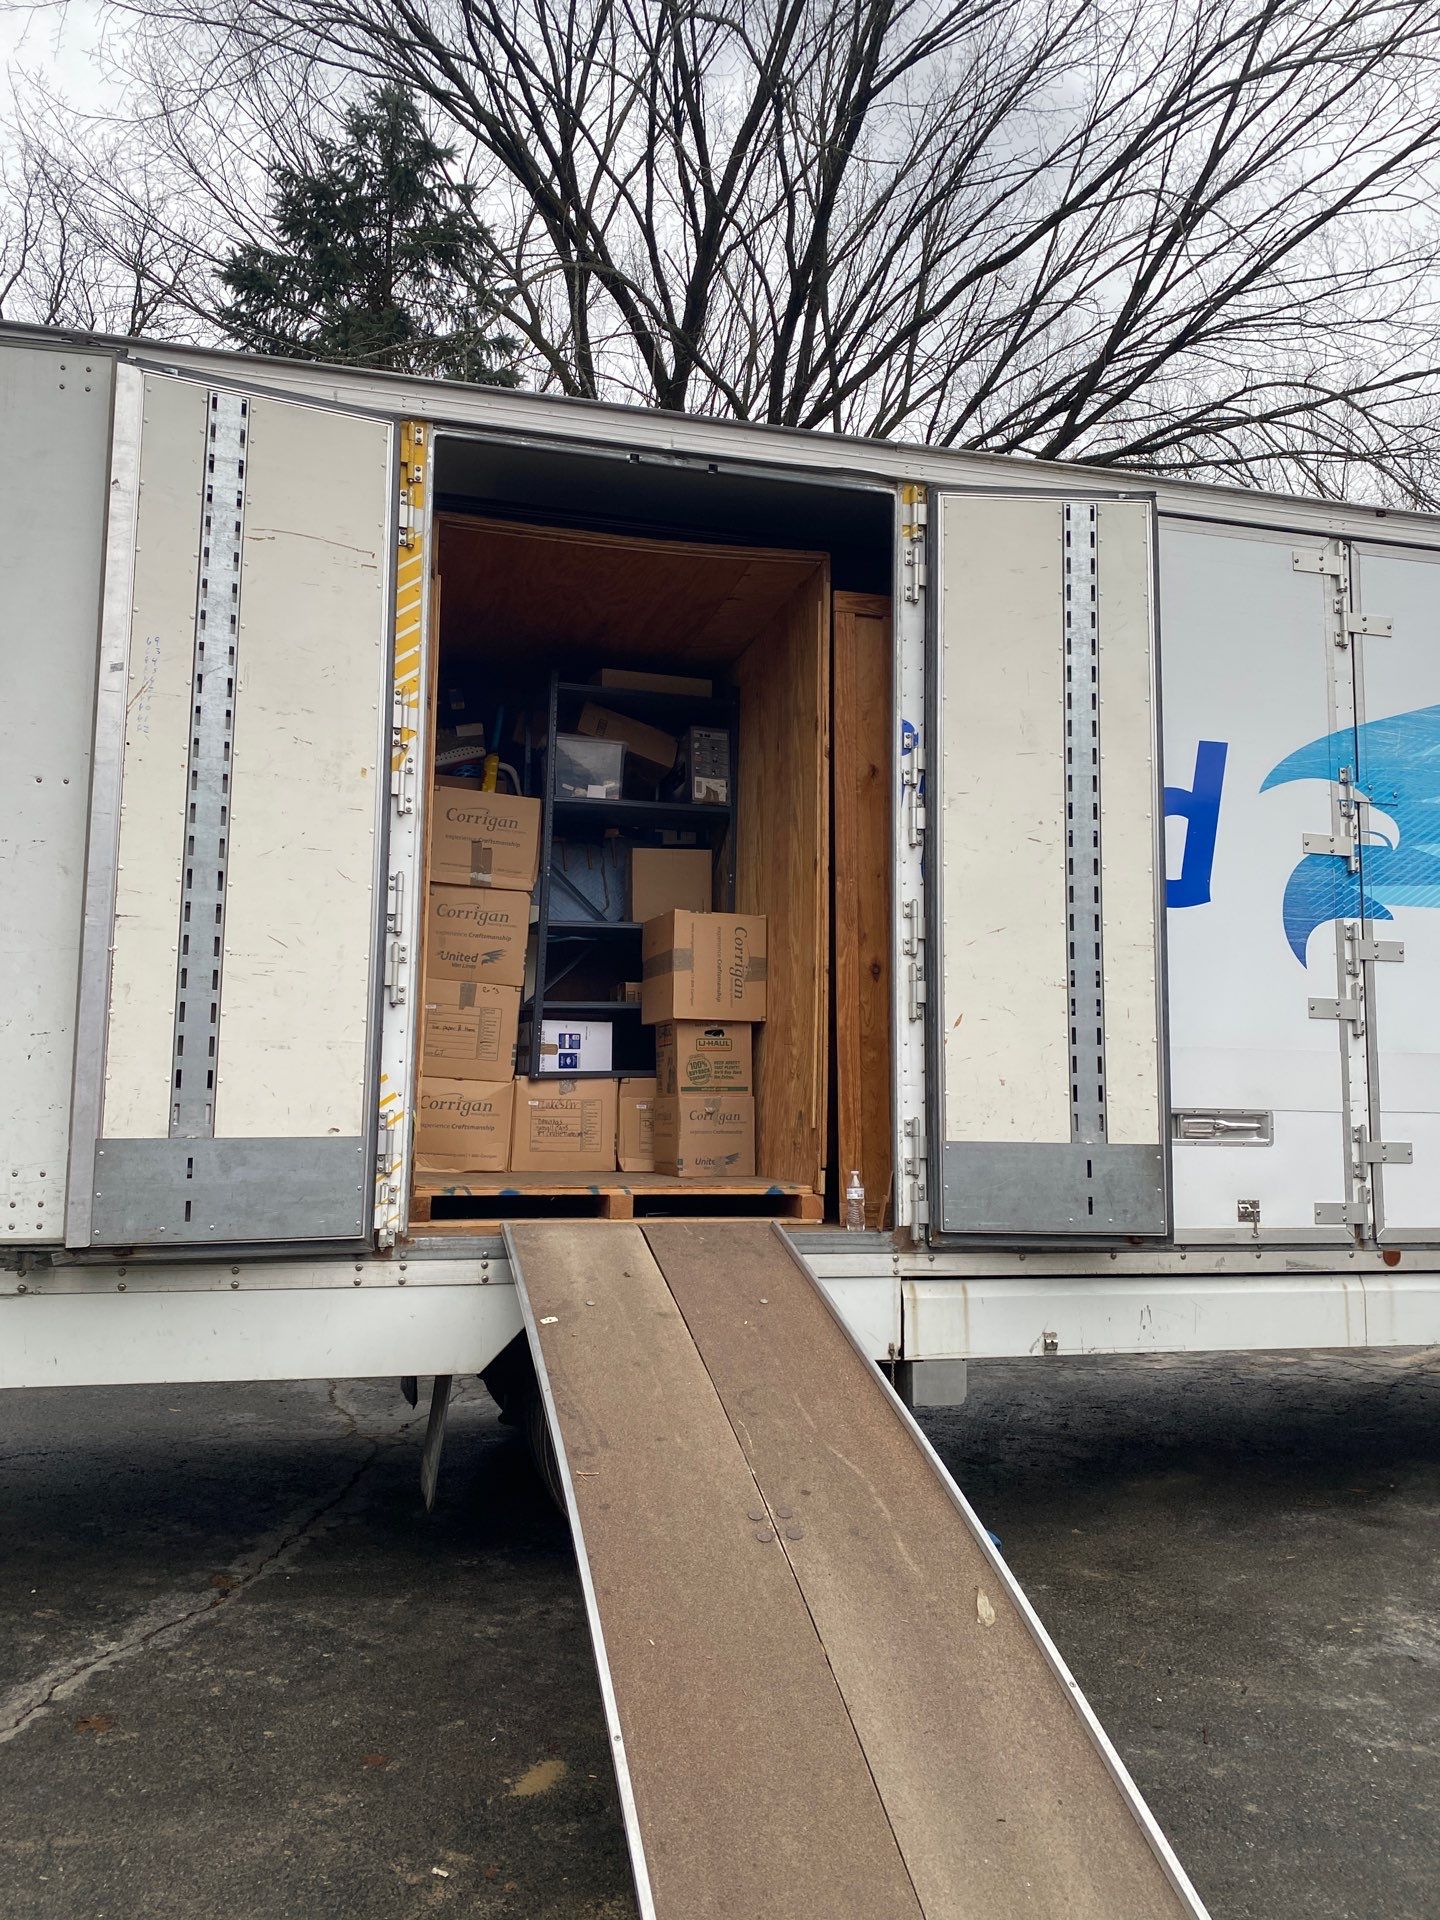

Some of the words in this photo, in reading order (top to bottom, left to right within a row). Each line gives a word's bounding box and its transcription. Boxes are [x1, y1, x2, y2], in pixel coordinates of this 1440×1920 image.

[446, 807, 519, 832] Corrigan
[436, 903, 509, 926] Corrigan
[439, 951, 479, 963] United
[729, 926, 748, 1000] Corrigan
[421, 1095, 493, 1117] Corrigan
[451, 1123, 496, 1132] Craftsmanship
